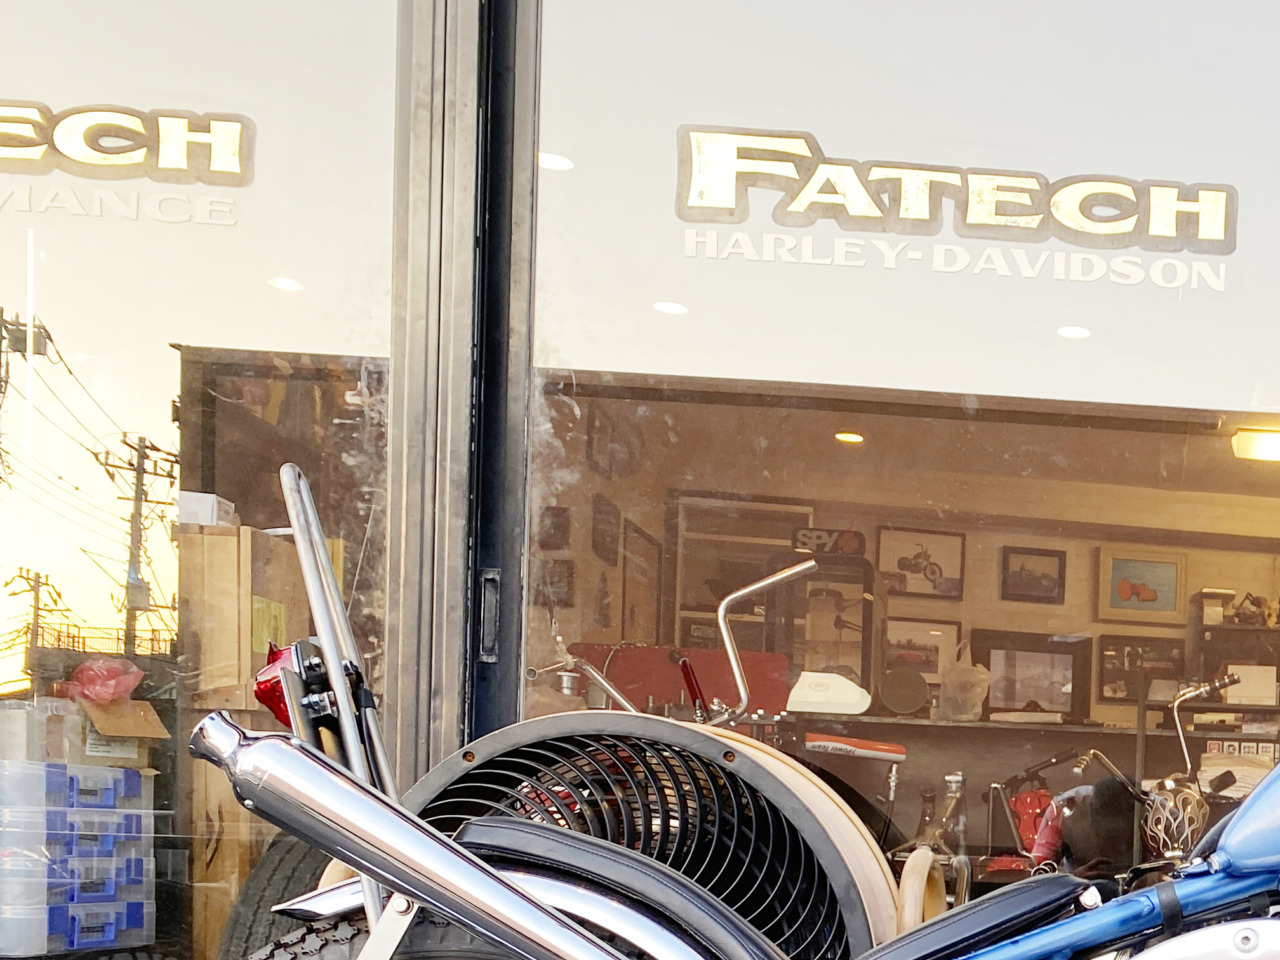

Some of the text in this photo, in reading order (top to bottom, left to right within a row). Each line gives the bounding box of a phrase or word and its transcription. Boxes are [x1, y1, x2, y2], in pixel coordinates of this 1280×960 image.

[682, 129, 1230, 244] FATECH
[683, 227, 1227, 293] HARLEY-DAVIDSON
[796, 529, 840, 552] SPY
